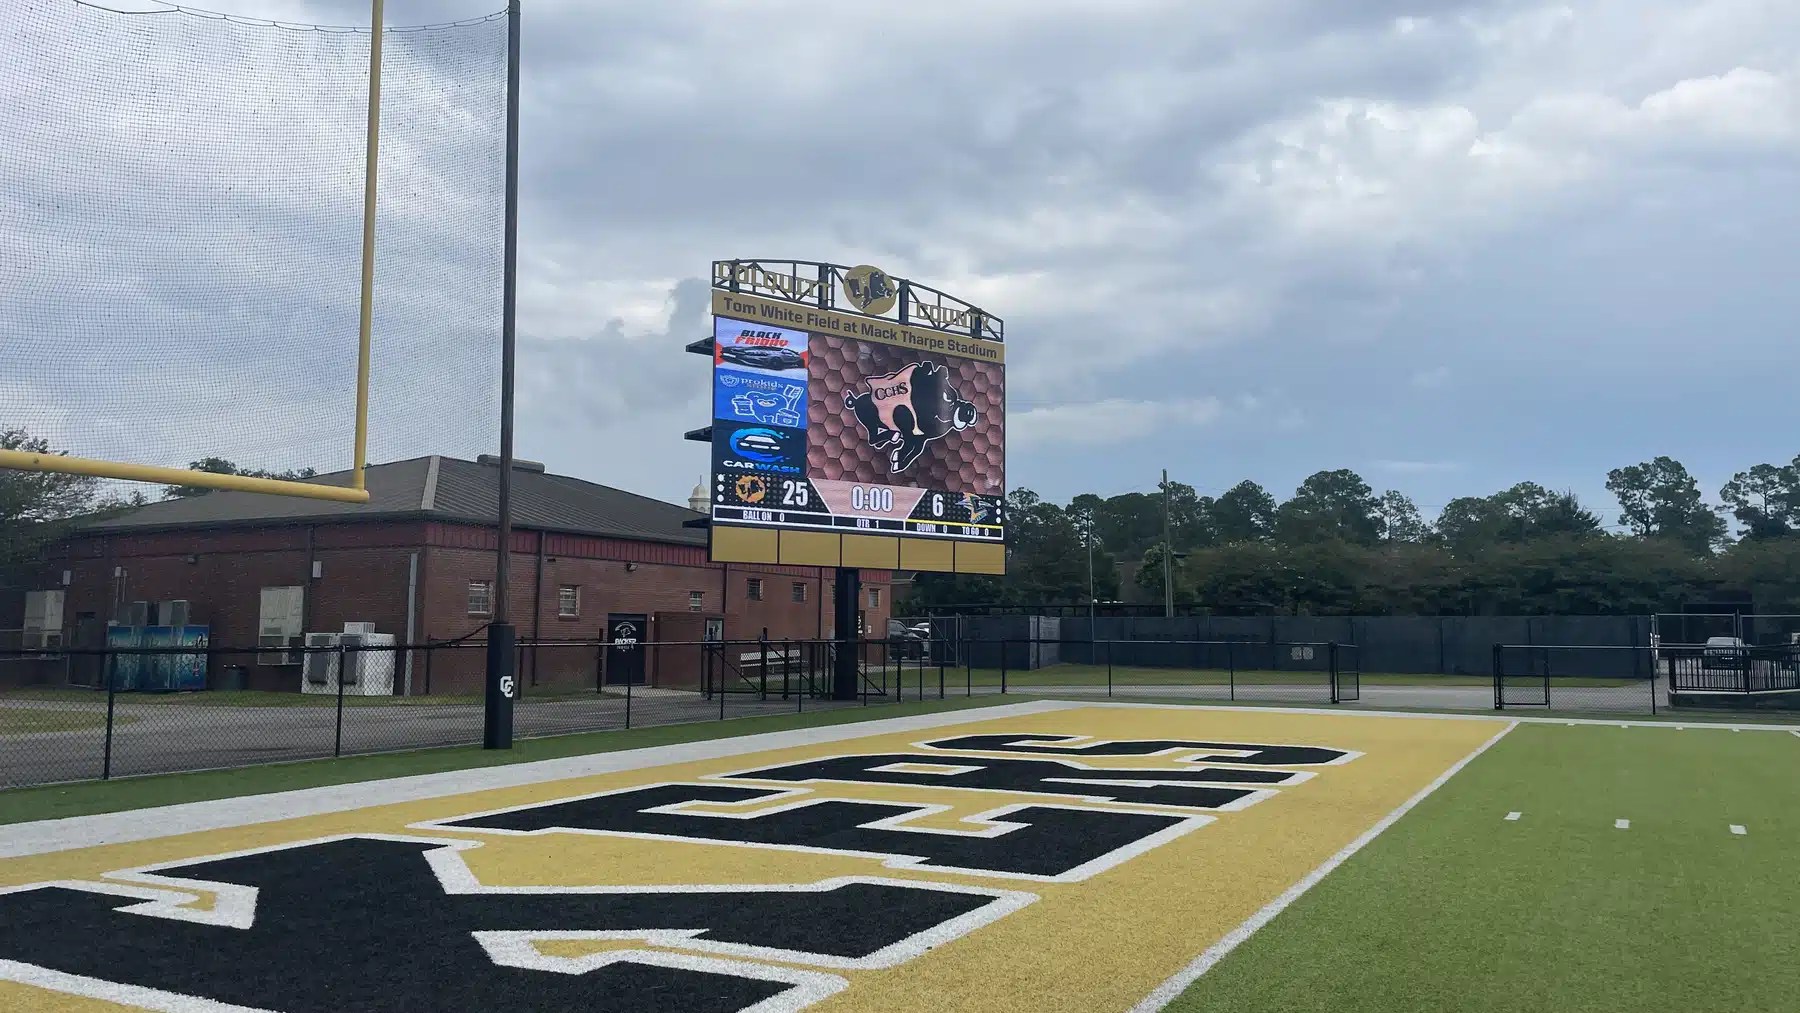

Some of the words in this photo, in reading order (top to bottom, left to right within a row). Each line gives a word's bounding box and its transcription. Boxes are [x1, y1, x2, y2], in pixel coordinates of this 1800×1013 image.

[718, 261, 831, 300] COLQUITT
[917, 302, 990, 331] COUNTY
[724, 297, 756, 315] Tom
[761, 303, 803, 324] White
[807, 313, 839, 330] Field
[843, 321, 858, 333] at
[861, 322, 897, 341] Mack
[901, 330, 944, 350] Tharpe
[948, 339, 997, 359] Stadium
[741, 329, 782, 339] BLACK
[735, 336, 789, 347] FRIDAY
[875, 382, 908, 400] CCHS
[782, 480, 808, 506] 25
[852, 485, 893, 512] 0:00
[932, 494, 944, 517] 6
[743, 510, 760, 520] BALL
[761, 512, 772, 521] ON
[779, 513, 785, 522] 0
[856, 519, 870, 528] QTR
[875, 520, 879, 528] 1
[916, 523, 936, 533] DOWN
[943, 525, 948, 533] 0
[984, 528, 989, 536] 0
